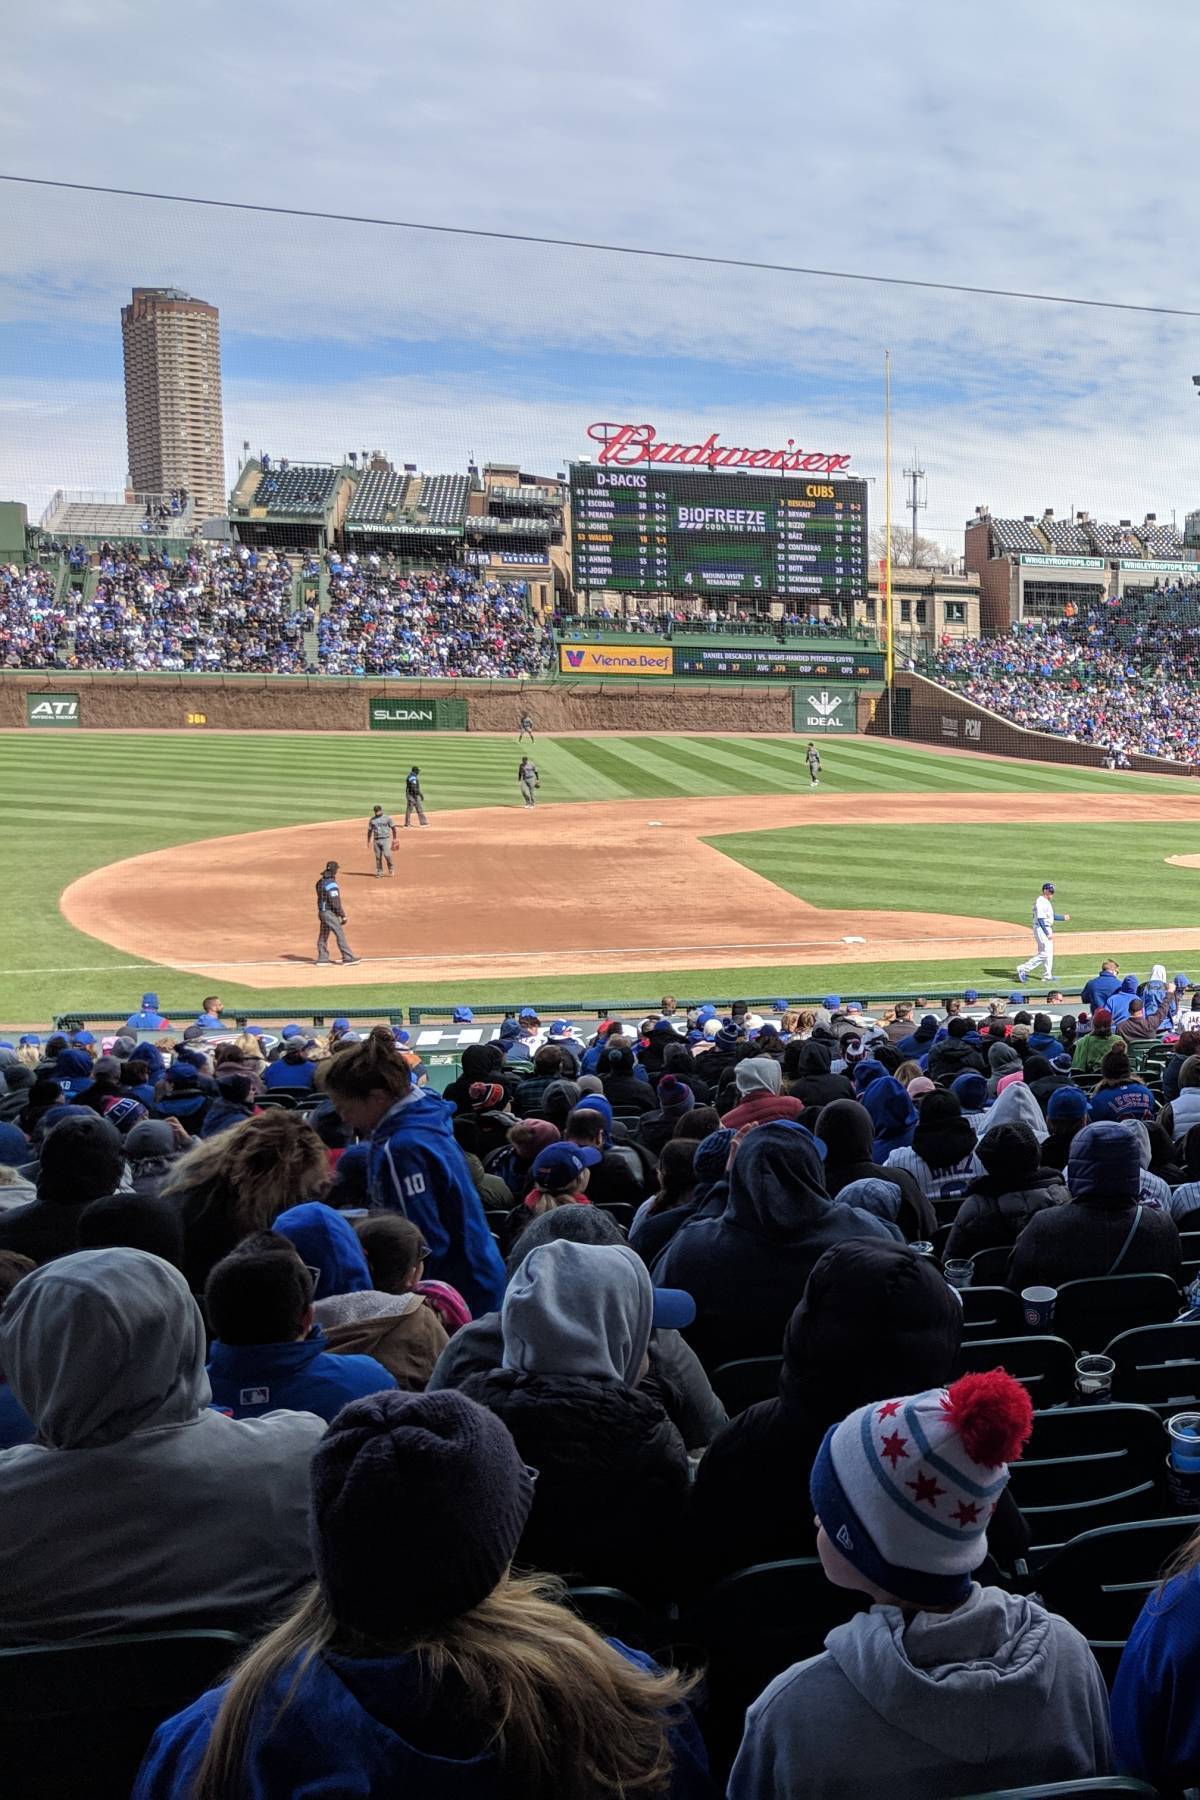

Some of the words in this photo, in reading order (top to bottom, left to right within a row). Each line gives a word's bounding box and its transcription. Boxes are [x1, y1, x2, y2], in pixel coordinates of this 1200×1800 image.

[588, 423, 850, 472] Budweiser
[597, 473, 646, 487] D-BACKS
[806, 485, 834, 497] CUBS
[1025, 557, 1100, 567] WRIGLEYROOFTOPS.COM
[1125, 562, 1197, 571] WRIGLEYROOFTOPS.COM
[685, 572, 693, 584] 4
[754, 576, 761, 587] 5
[592, 654, 636, 666] Vienna
[640, 656, 669, 670] Beef
[32, 702, 78, 714] ATI
[374, 710, 432, 720] SLOAN
[807, 716, 843, 726] IDEAL
[1108, 1093, 1149, 1114] LESTER
[404, 1173, 426, 1196] 10
